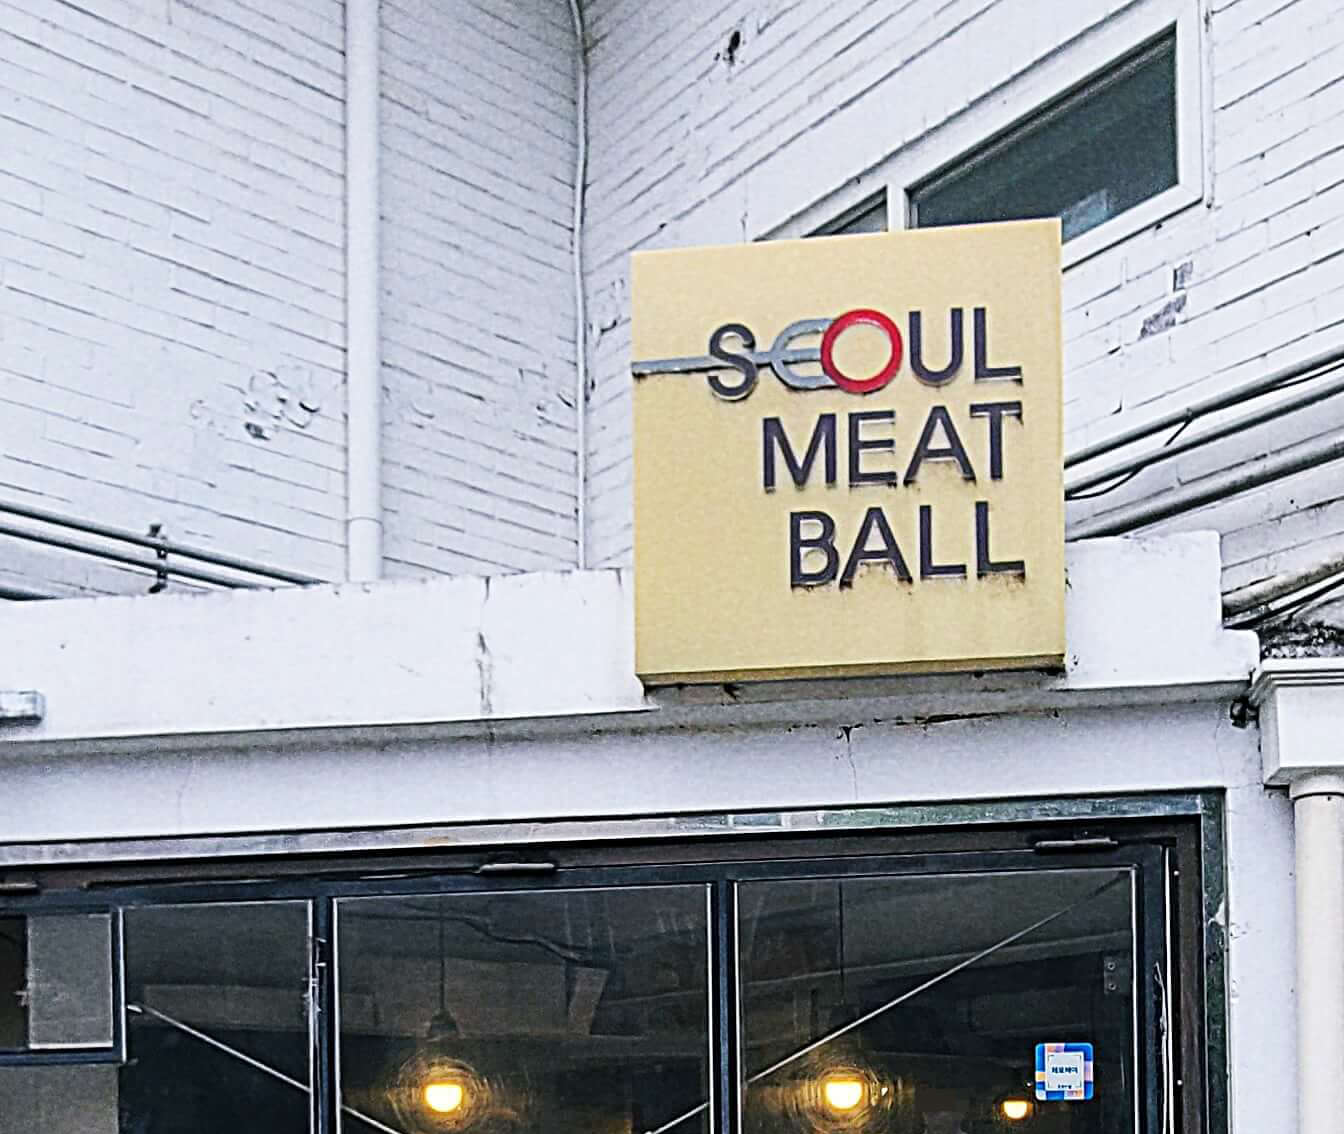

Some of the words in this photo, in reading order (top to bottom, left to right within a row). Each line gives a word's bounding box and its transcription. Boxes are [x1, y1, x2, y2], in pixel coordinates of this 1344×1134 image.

[707, 306, 1024, 402] SEOUL
[762, 401, 1023, 492] MEAT
[789, 501, 1025, 589] BALL
